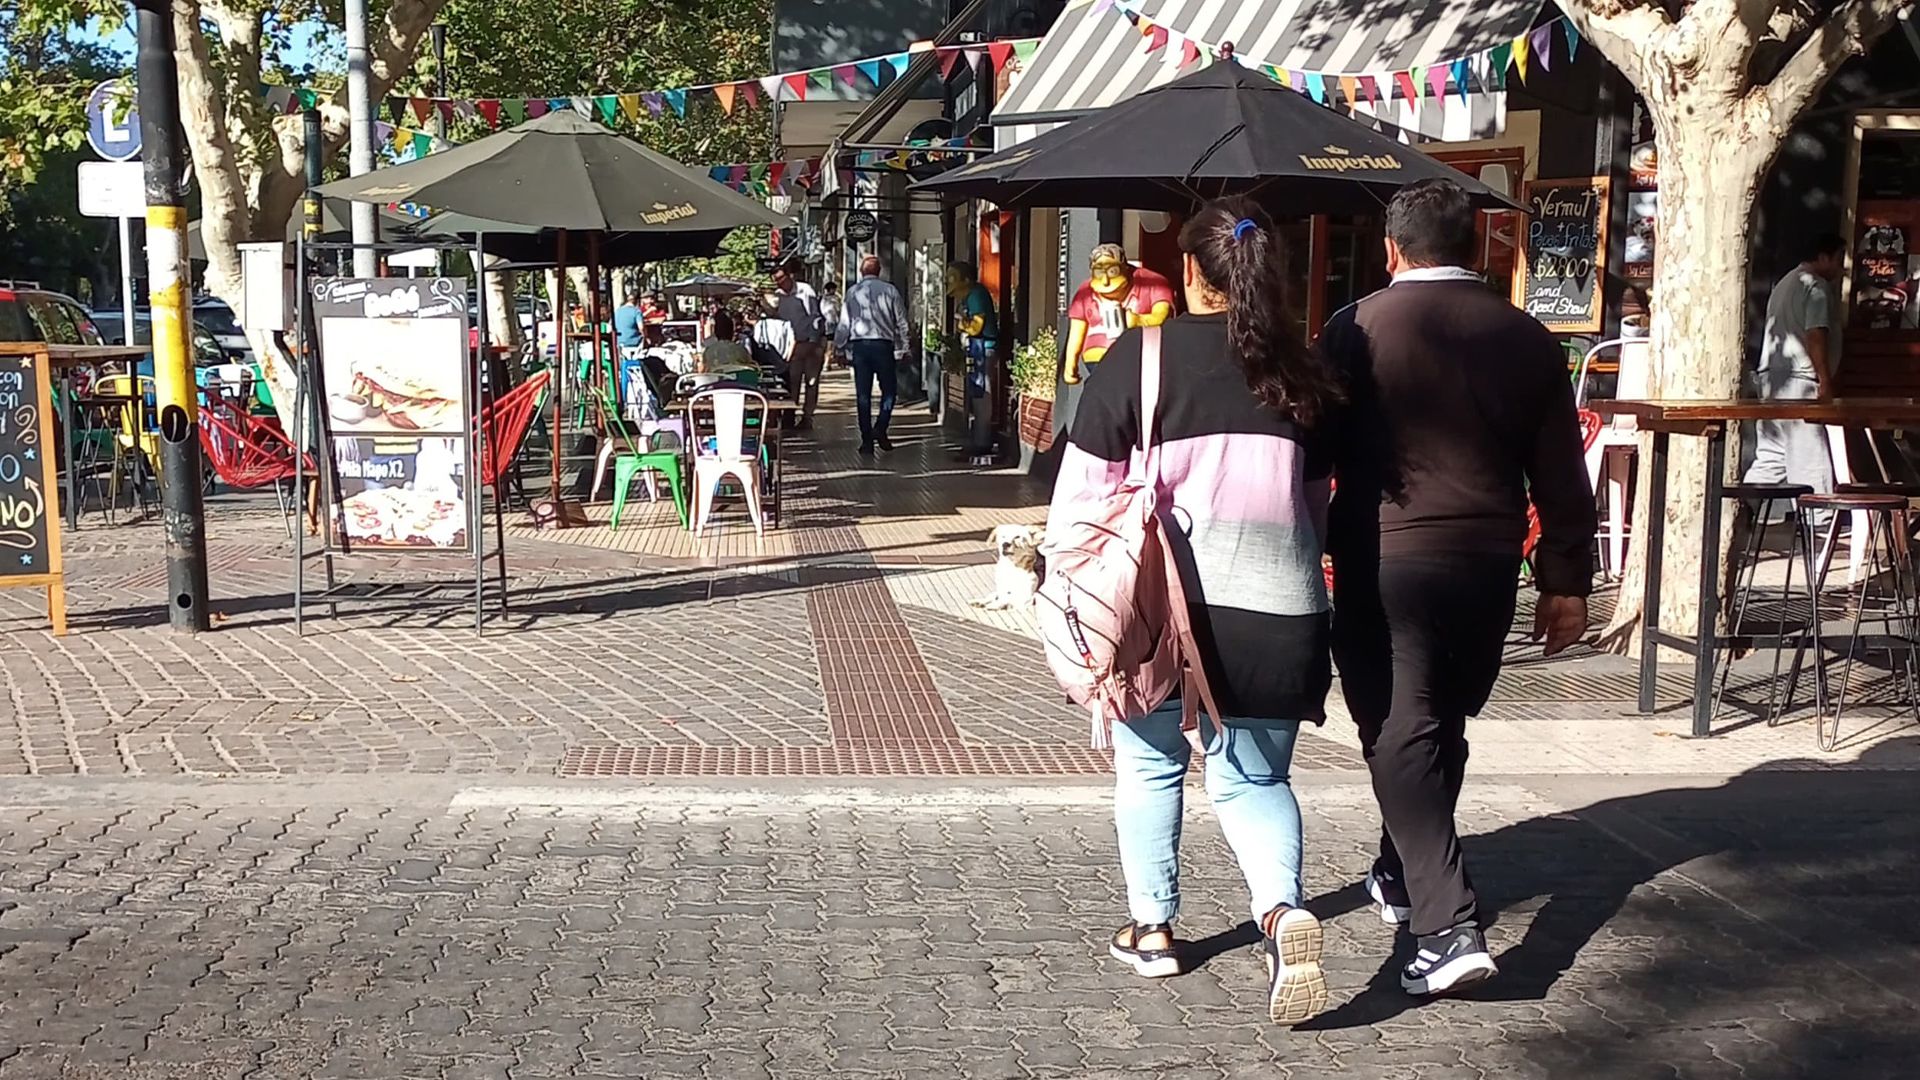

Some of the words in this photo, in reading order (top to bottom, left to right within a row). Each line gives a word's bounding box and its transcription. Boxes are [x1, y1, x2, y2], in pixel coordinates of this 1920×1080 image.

[1299, 154, 1402, 172] Imperial
[640, 202, 698, 224] Imperial
[1533, 188, 1596, 219] Vermut
[1533, 256, 1590, 282] $2800
[1533, 281, 1566, 298] and
